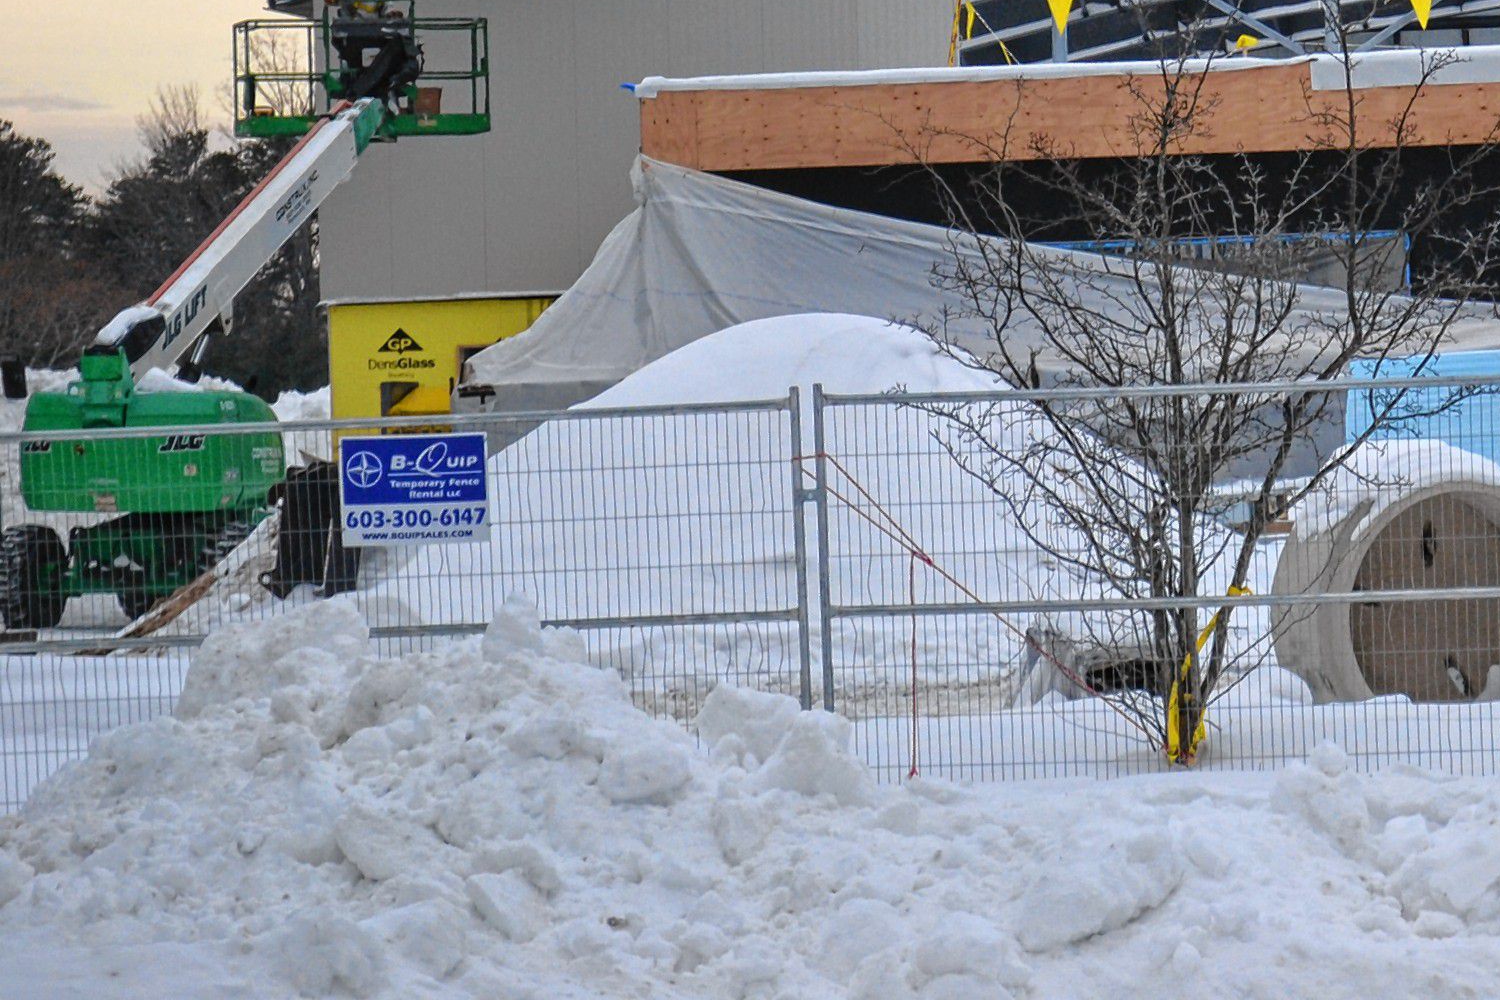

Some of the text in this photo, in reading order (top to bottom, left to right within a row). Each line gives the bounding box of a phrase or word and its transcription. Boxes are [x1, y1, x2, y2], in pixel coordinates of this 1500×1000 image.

[162, 284, 208, 351] JLG LIFT
[387, 338, 412, 350] GP
[368, 357, 435, 370] DensGlass
[159, 433, 206, 452] JLG
[390, 477, 480, 489] Temporary Fence
[409, 490, 444, 499] Rental
[346, 507, 487, 529] 603-300-6147
[362, 530, 474, 540] WWW.BQUIPSALES.COM
